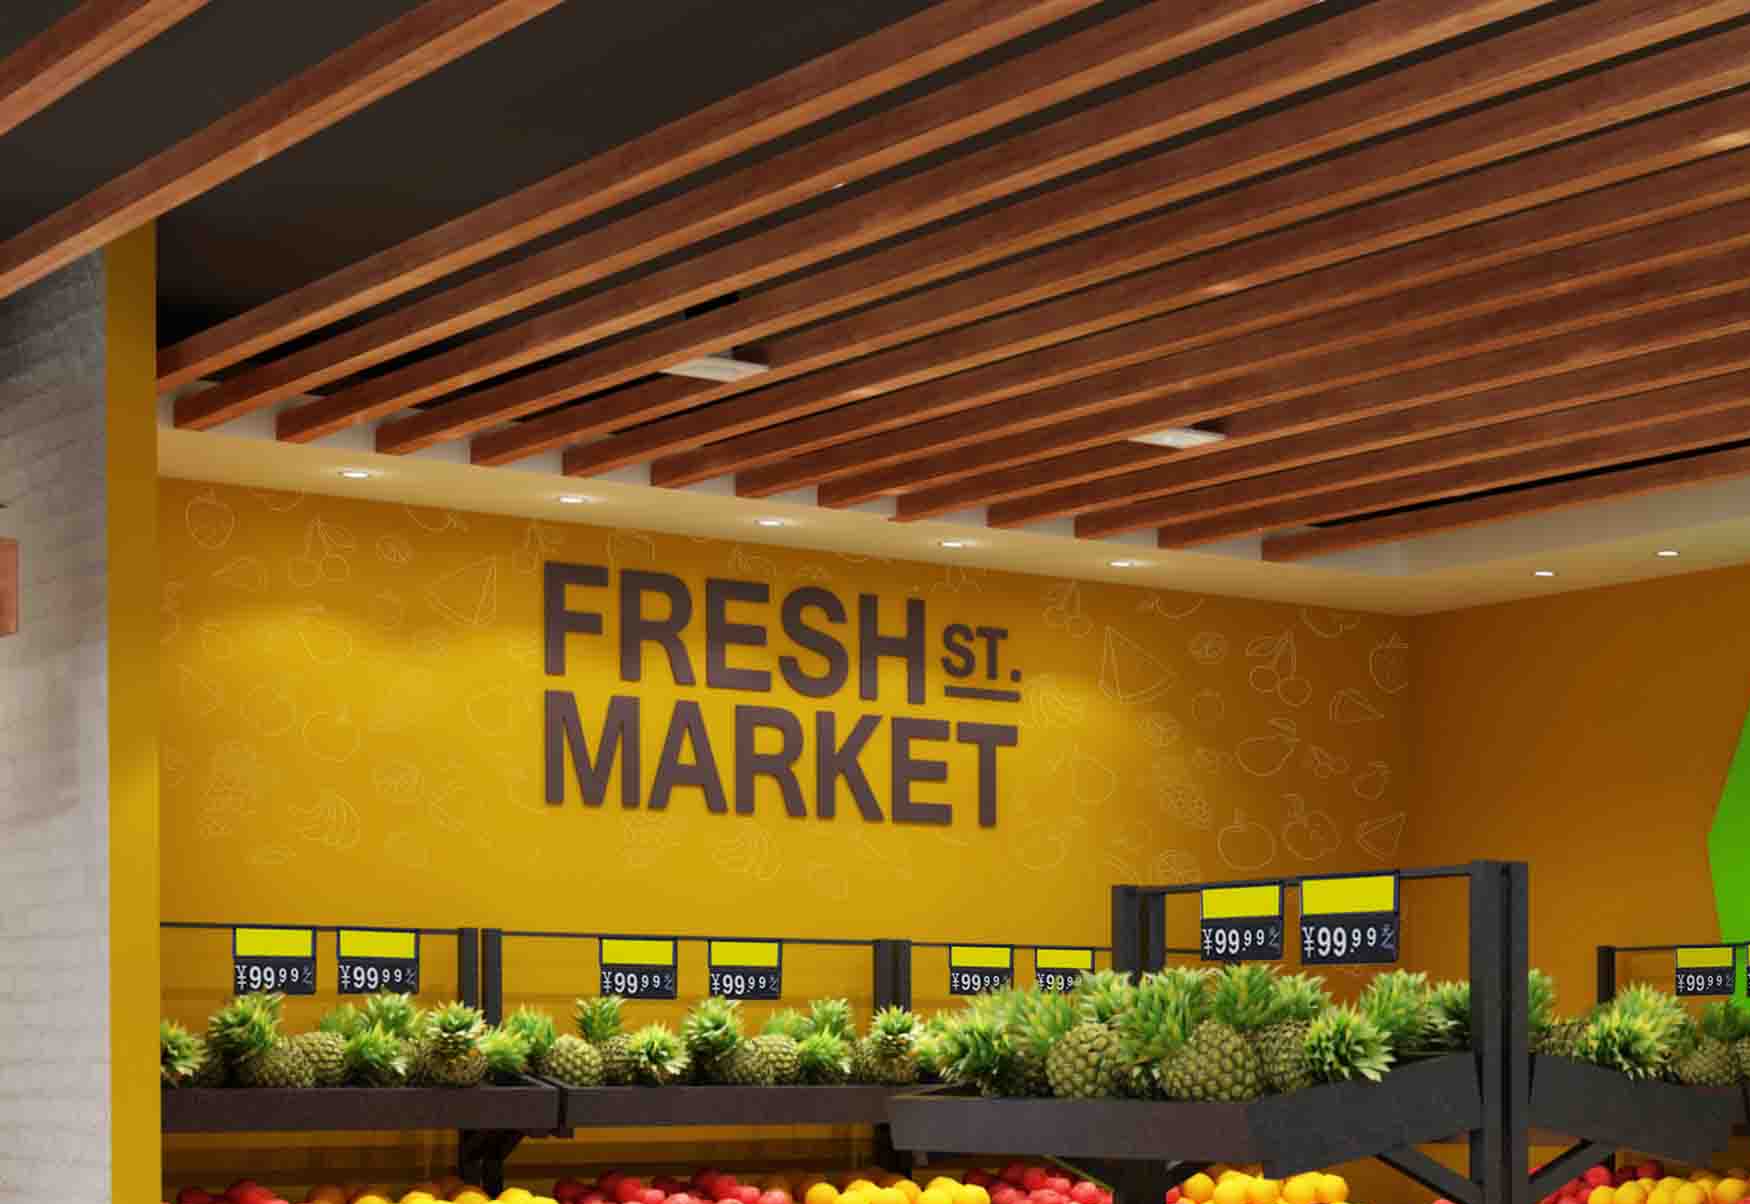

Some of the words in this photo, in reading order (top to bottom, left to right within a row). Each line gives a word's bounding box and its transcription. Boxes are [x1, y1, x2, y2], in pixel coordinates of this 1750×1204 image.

[543, 561, 926, 705] FRESH
[940, 623, 1022, 683] ST.
[543, 689, 1019, 829] MARKET
[1202, 927, 1265, 955] ¥99.99
[1302, 927, 1376, 958] ¥99.99
[235, 965, 299, 990] ¥99.99
[339, 965, 402, 990] ¥99.99
[602, 970, 661, 994] ¥99.99
[711, 972, 766, 996] ¥99.99
[952, 973, 1000, 991] ¥9999
[1676, 973, 1723, 993] ¥99.99
